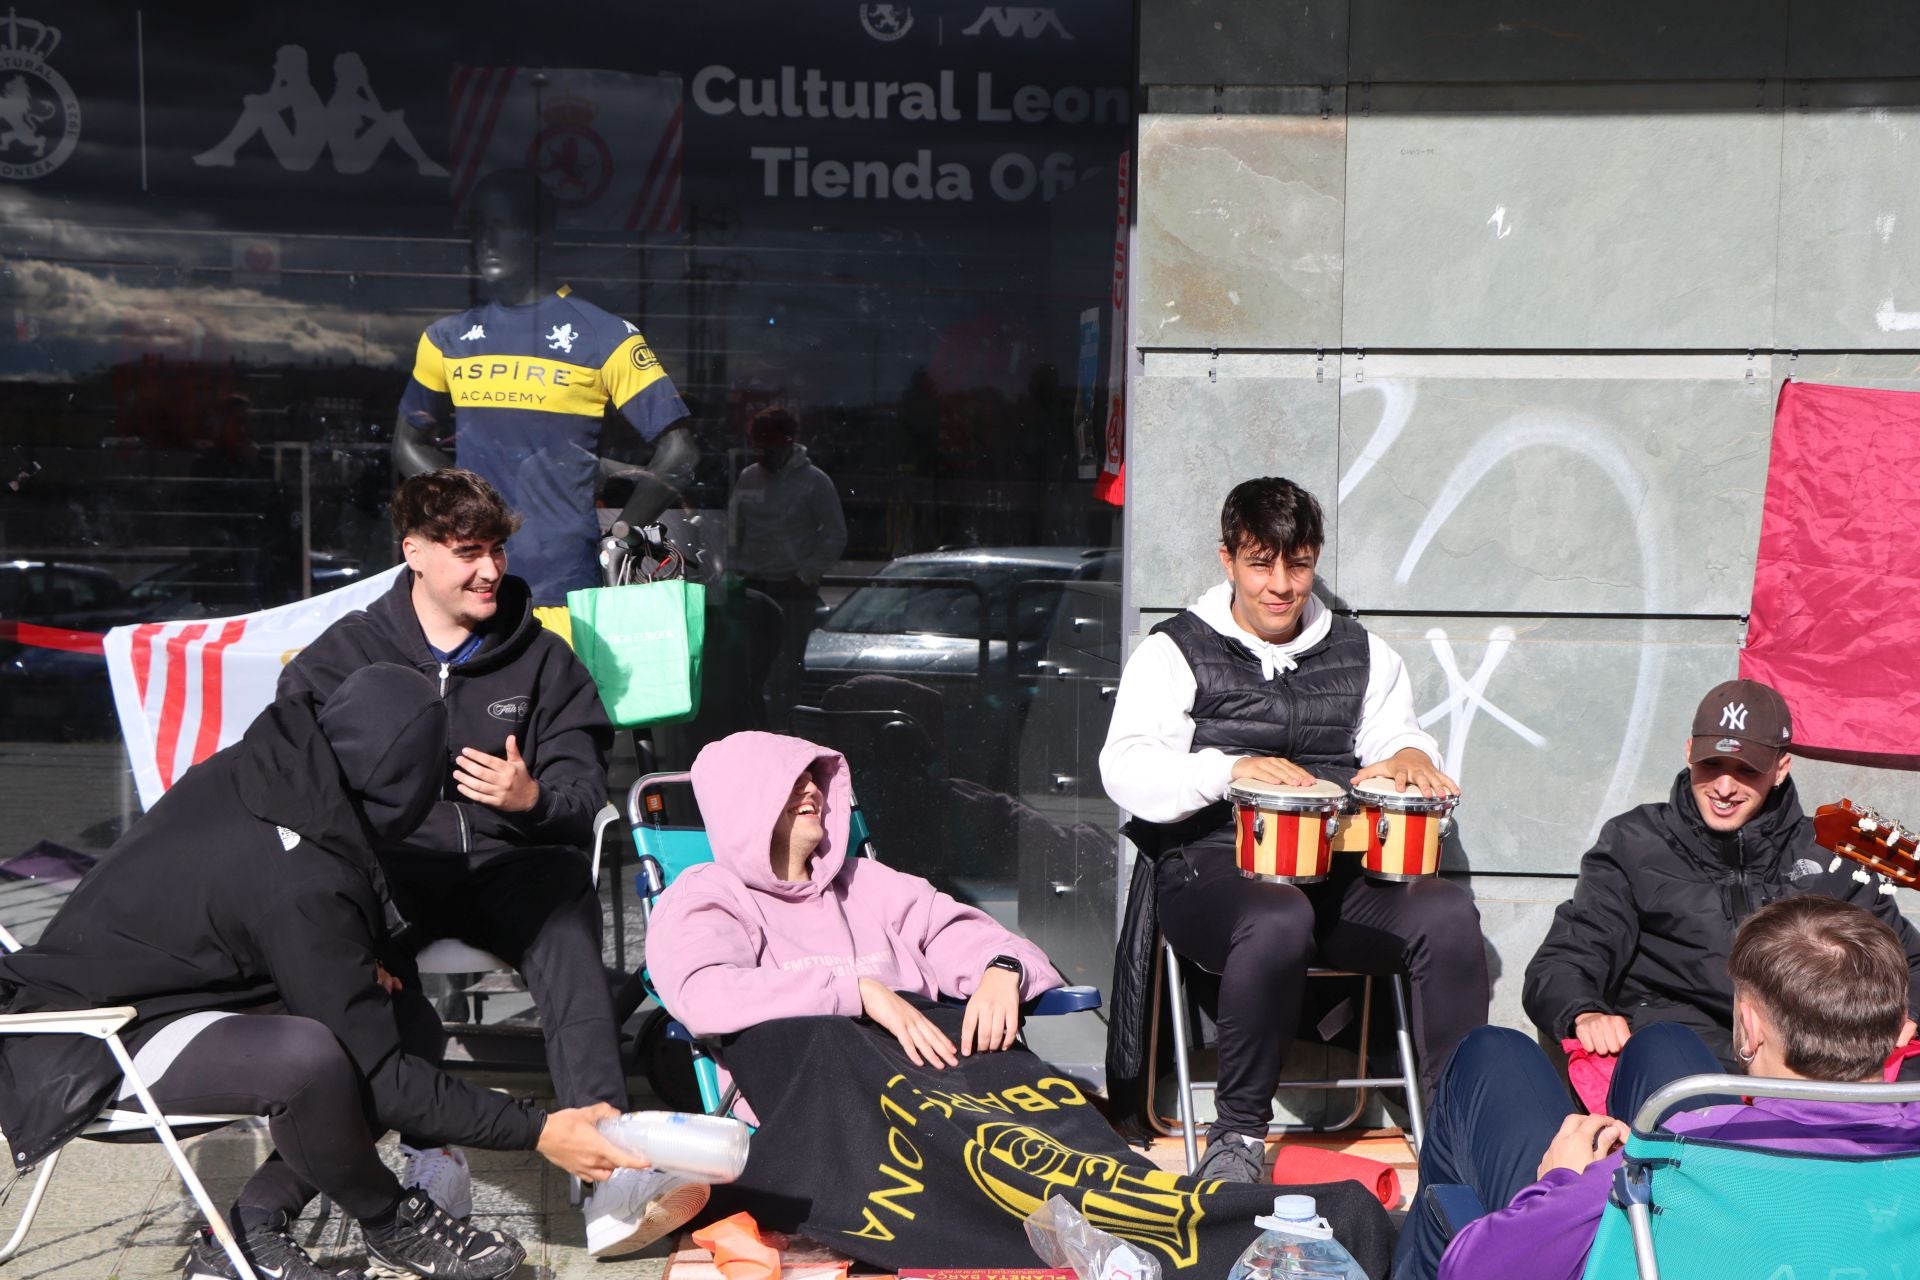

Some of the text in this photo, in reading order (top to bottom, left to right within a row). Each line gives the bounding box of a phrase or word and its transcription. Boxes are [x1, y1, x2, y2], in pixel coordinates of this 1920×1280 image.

[692, 64, 1131, 125] Cultural Leon
[751, 146, 1104, 203] Tienda Ofi
[460, 390, 546, 405] ACADEMY
[1719, 701, 1749, 731] NY
